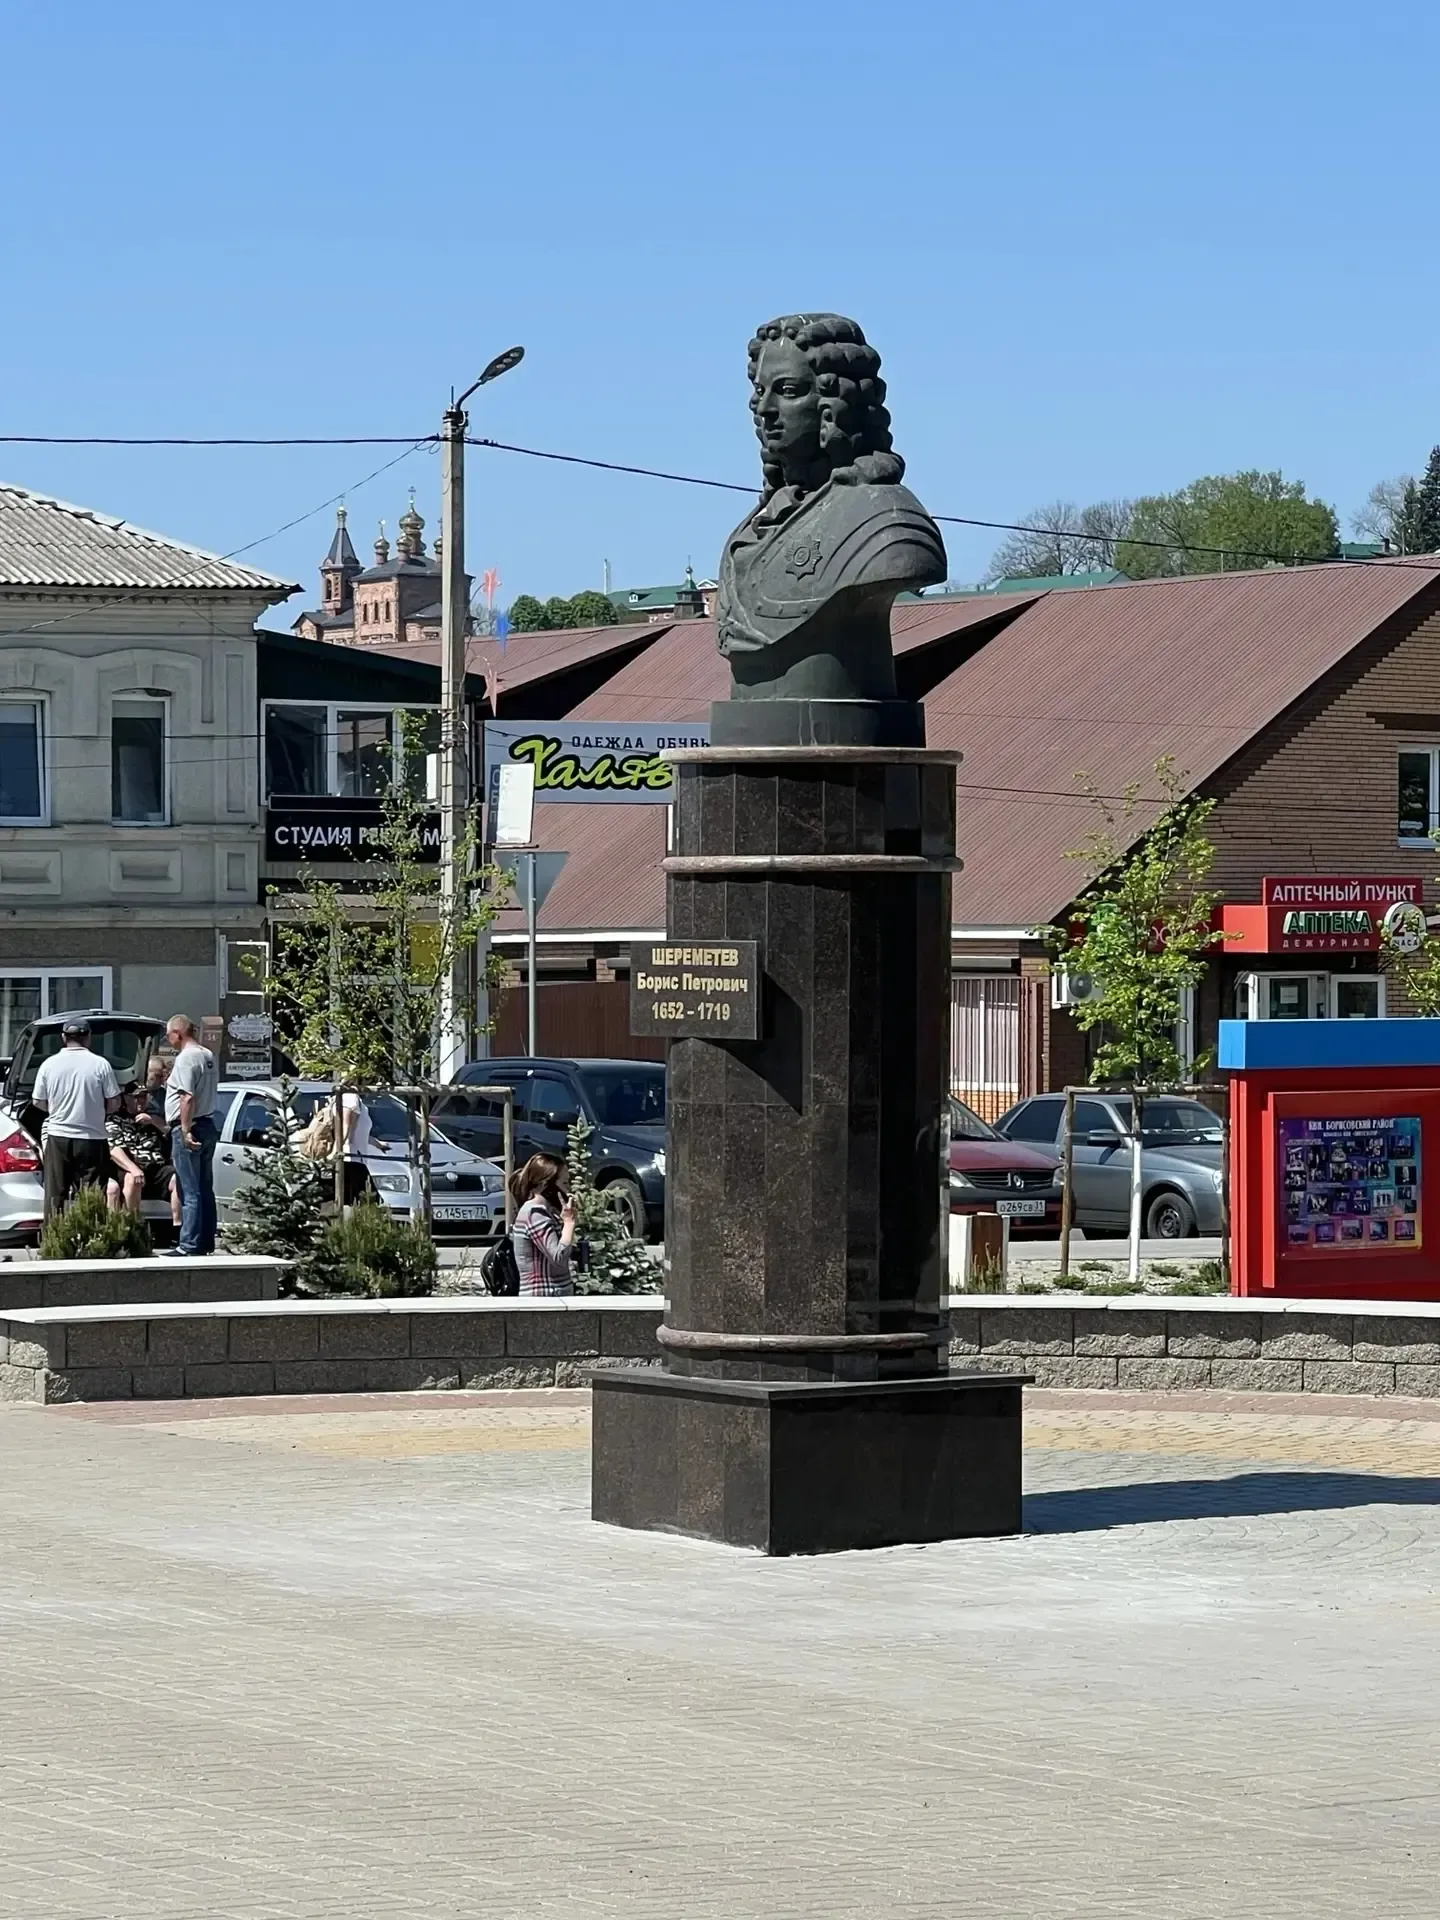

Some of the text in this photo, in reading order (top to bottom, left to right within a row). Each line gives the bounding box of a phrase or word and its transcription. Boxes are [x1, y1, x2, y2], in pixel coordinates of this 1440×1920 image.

[572, 736, 710, 749] ОДЕЖДА ОБУВЬ
[275, 826, 351, 847] СТУДИЯ
[1272, 880, 1416, 902] АПТЕЧНЫЙ ПУНКТ
[1284, 911, 1374, 934] АПТЕКА
[1282, 938, 1370, 949] ДЕЖУРНАЯ
[651, 948, 739, 967] ШЕРЕМЕТЕВ
[637, 972, 748, 995] Борис Петрович
[652, 1002, 685, 1019] 1652
[697, 1002, 731, 1021] 1719
